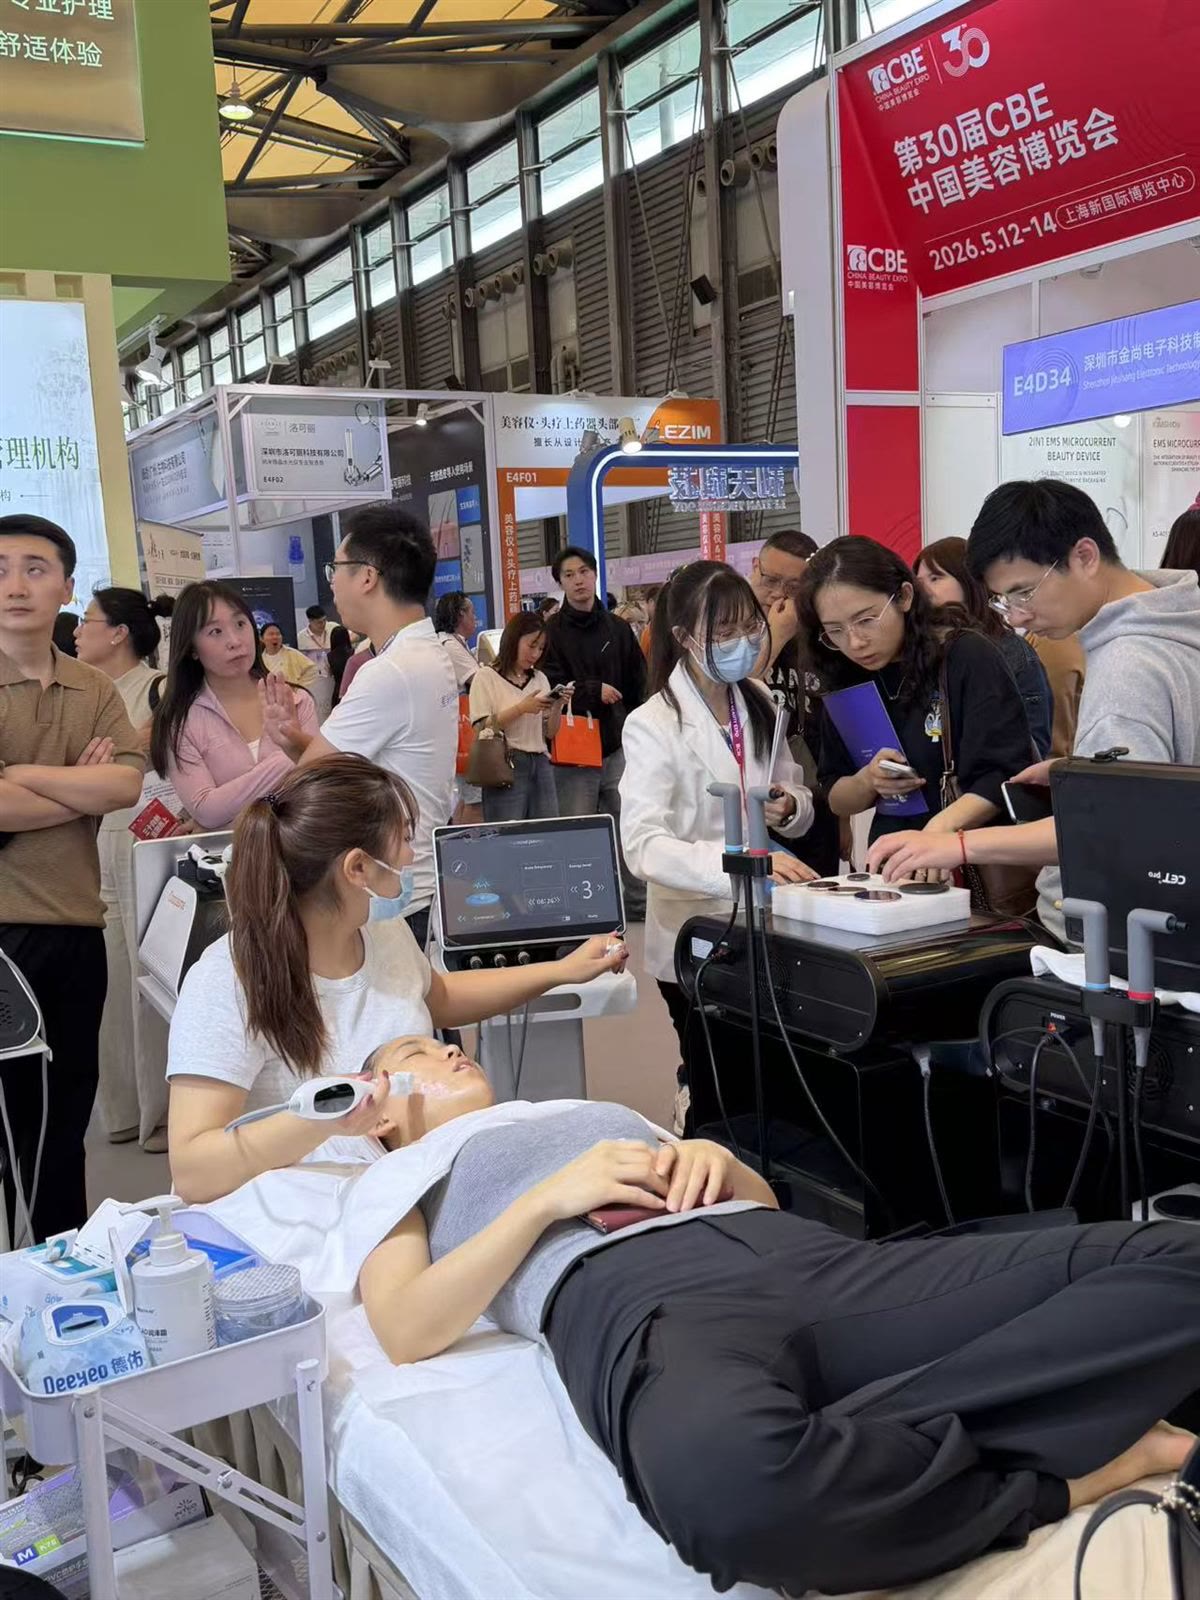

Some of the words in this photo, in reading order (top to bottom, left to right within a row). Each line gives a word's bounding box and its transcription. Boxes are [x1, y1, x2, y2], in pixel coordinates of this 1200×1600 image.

[0, 30, 103, 67] 舒适体验
[887, 46, 928, 84] CBE
[941, 24, 990, 78] 30
[914, 73, 930, 86] EXPO
[893, 82, 1054, 178] 第30届CBE
[907, 107, 1120, 215] 中国美容博览会
[929, 211, 1058, 271] 2026.5.12-14
[1064, 171, 1186, 224] 上海新国际博览中心
[868, 247, 908, 274] CBE
[892, 275, 908, 283] EXPO
[1013, 366, 1072, 397] E4D34
[659, 424, 712, 439] EZIM
[1045, 436, 1061, 447] EMS
[1062, 437, 1116, 447] MICROCURRENT
[0, 435, 79, 470] 理机构
[1153, 439, 1166, 448] EMS
[1047, 451, 1075, 461] BEAUTY
[1076, 451, 1101, 461] DEVICE
[506, 472, 537, 483] E4F01
[581, 880, 593, 899] 3
[43, 1362, 108, 1394] Deeyeo
[111, 1350, 144, 1375] 德佑
[16, 1547, 34, 1562] M
